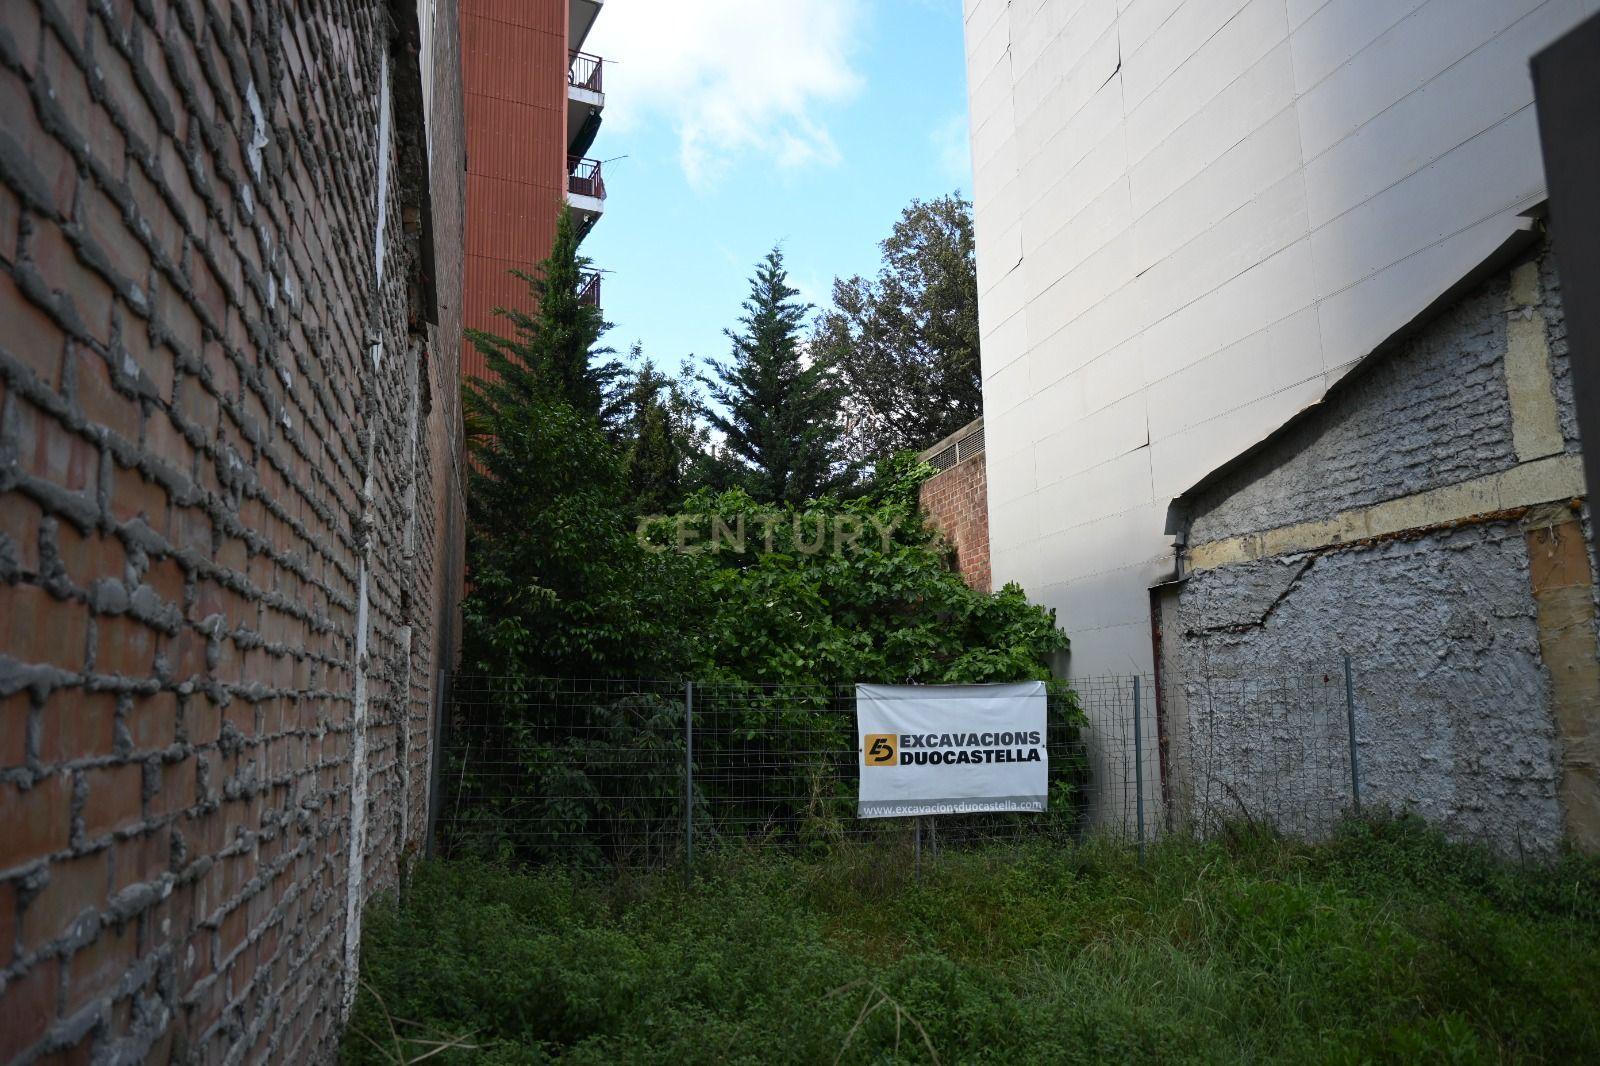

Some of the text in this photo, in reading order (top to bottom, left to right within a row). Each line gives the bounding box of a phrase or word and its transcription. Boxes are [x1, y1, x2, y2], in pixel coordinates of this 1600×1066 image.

[902, 732, 1041, 748] EXCAVACIONS
[901, 748, 1041, 765] DUOCASTELLA
[864, 800, 1042, 816] www.excavacionsduocastella.com
